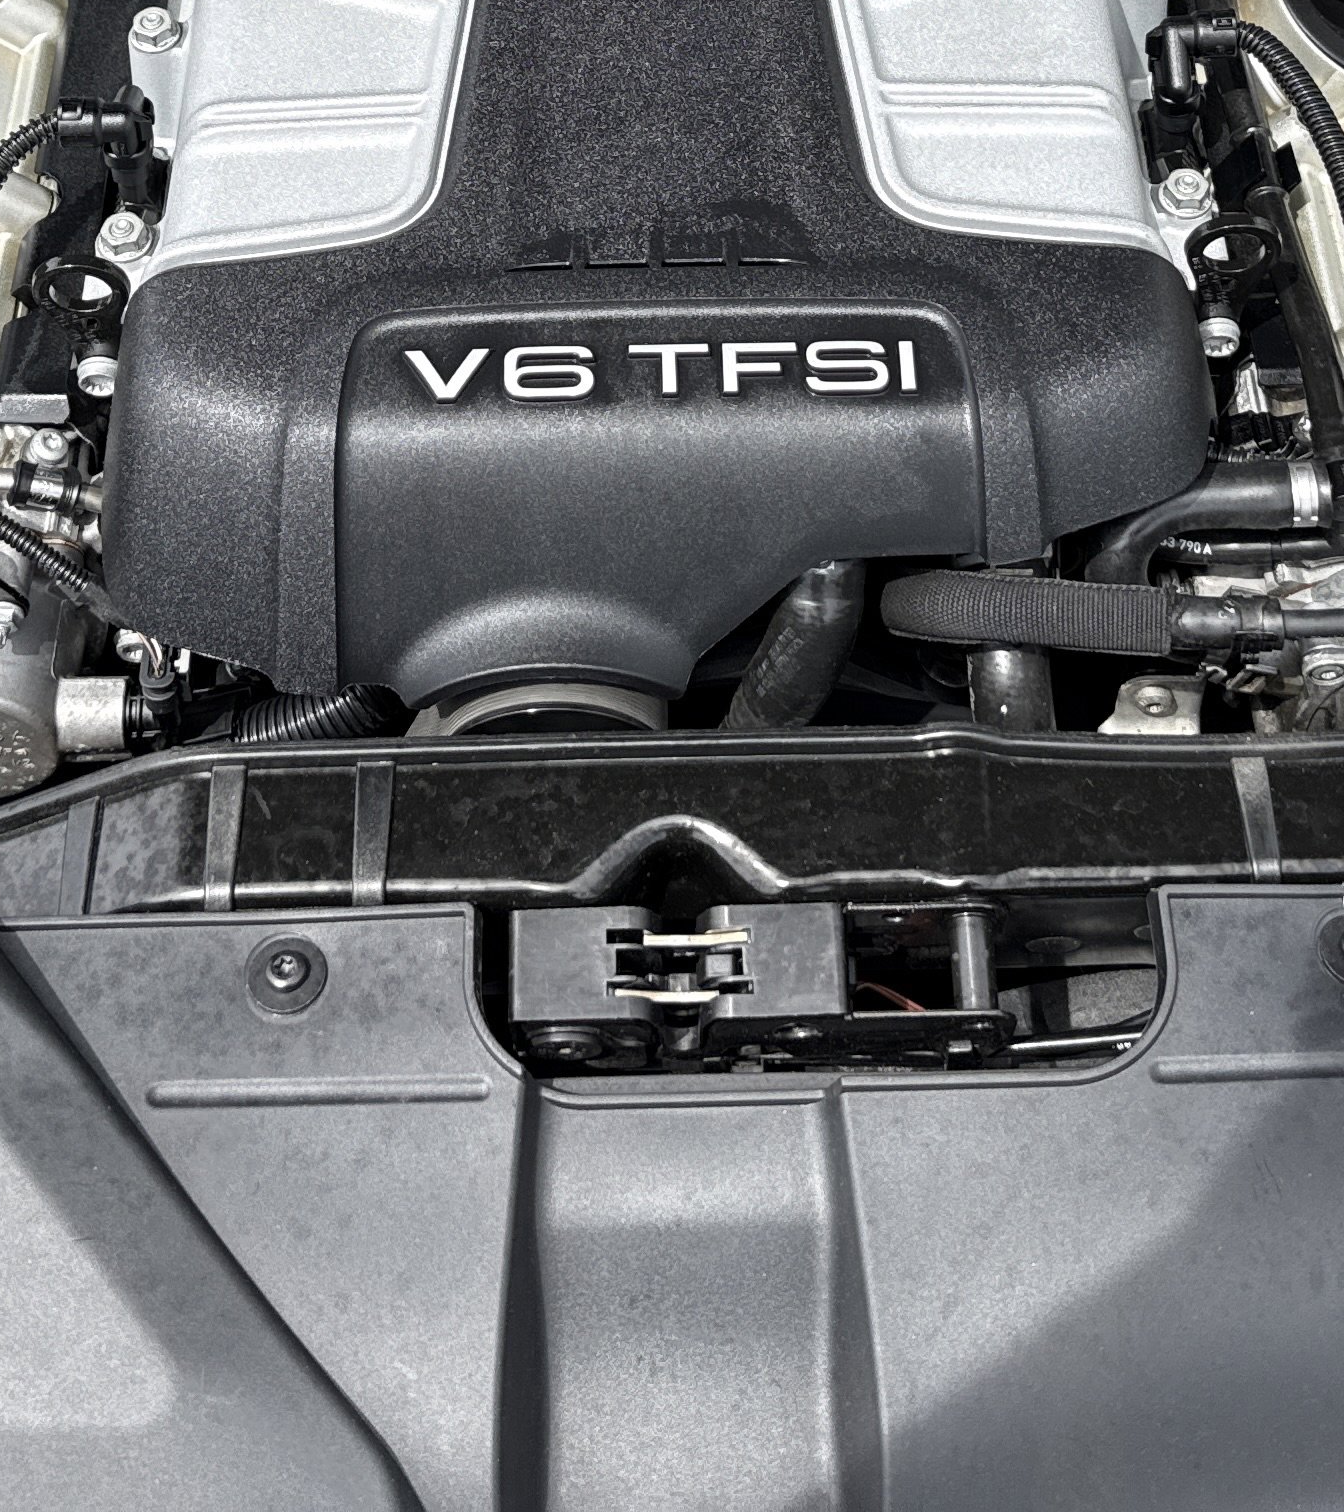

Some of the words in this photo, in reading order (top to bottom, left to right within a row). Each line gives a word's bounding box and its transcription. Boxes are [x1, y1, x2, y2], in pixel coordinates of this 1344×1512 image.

[402, 345, 598, 404] V6
[627, 339, 920, 398] TFSI
[1179, 539, 1201, 554] 790
[1203, 543, 1212, 555] A
